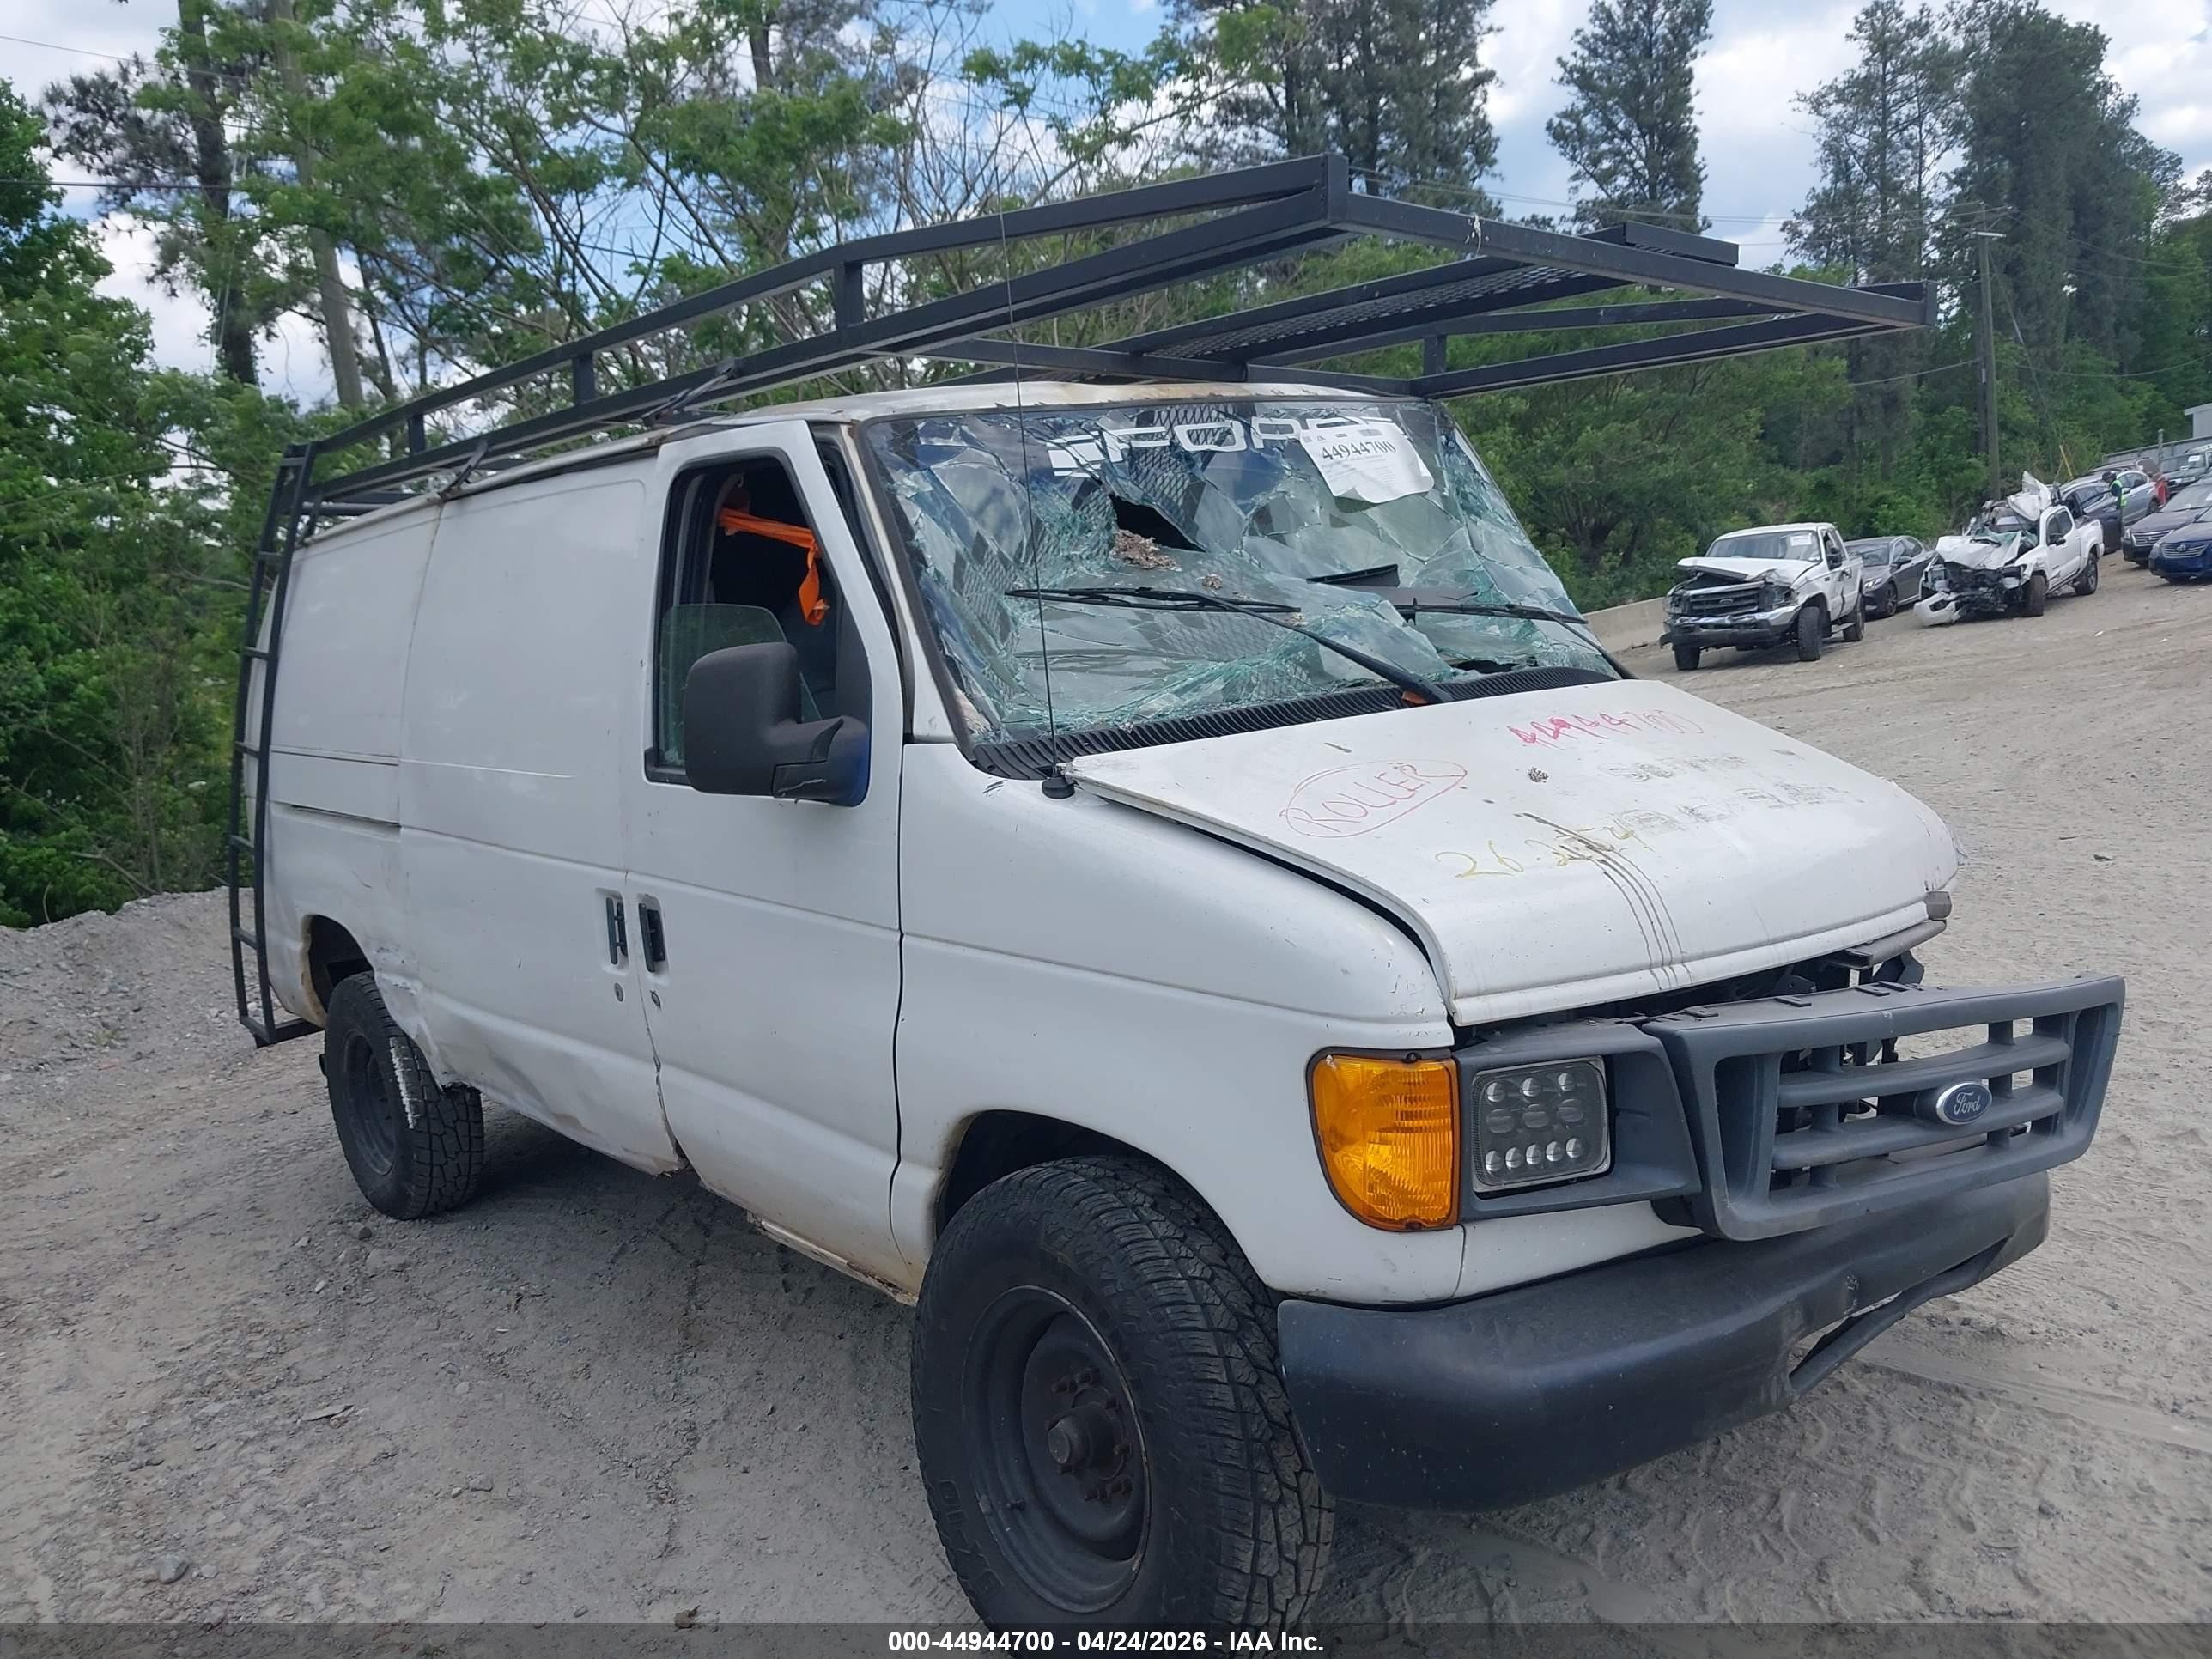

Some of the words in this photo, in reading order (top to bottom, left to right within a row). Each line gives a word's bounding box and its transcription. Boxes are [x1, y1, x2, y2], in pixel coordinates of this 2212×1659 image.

[1322, 439, 1397, 461] 44944700
[1279, 763, 1465, 833] ROLLER
[1954, 1091, 1981, 1115] Ford
